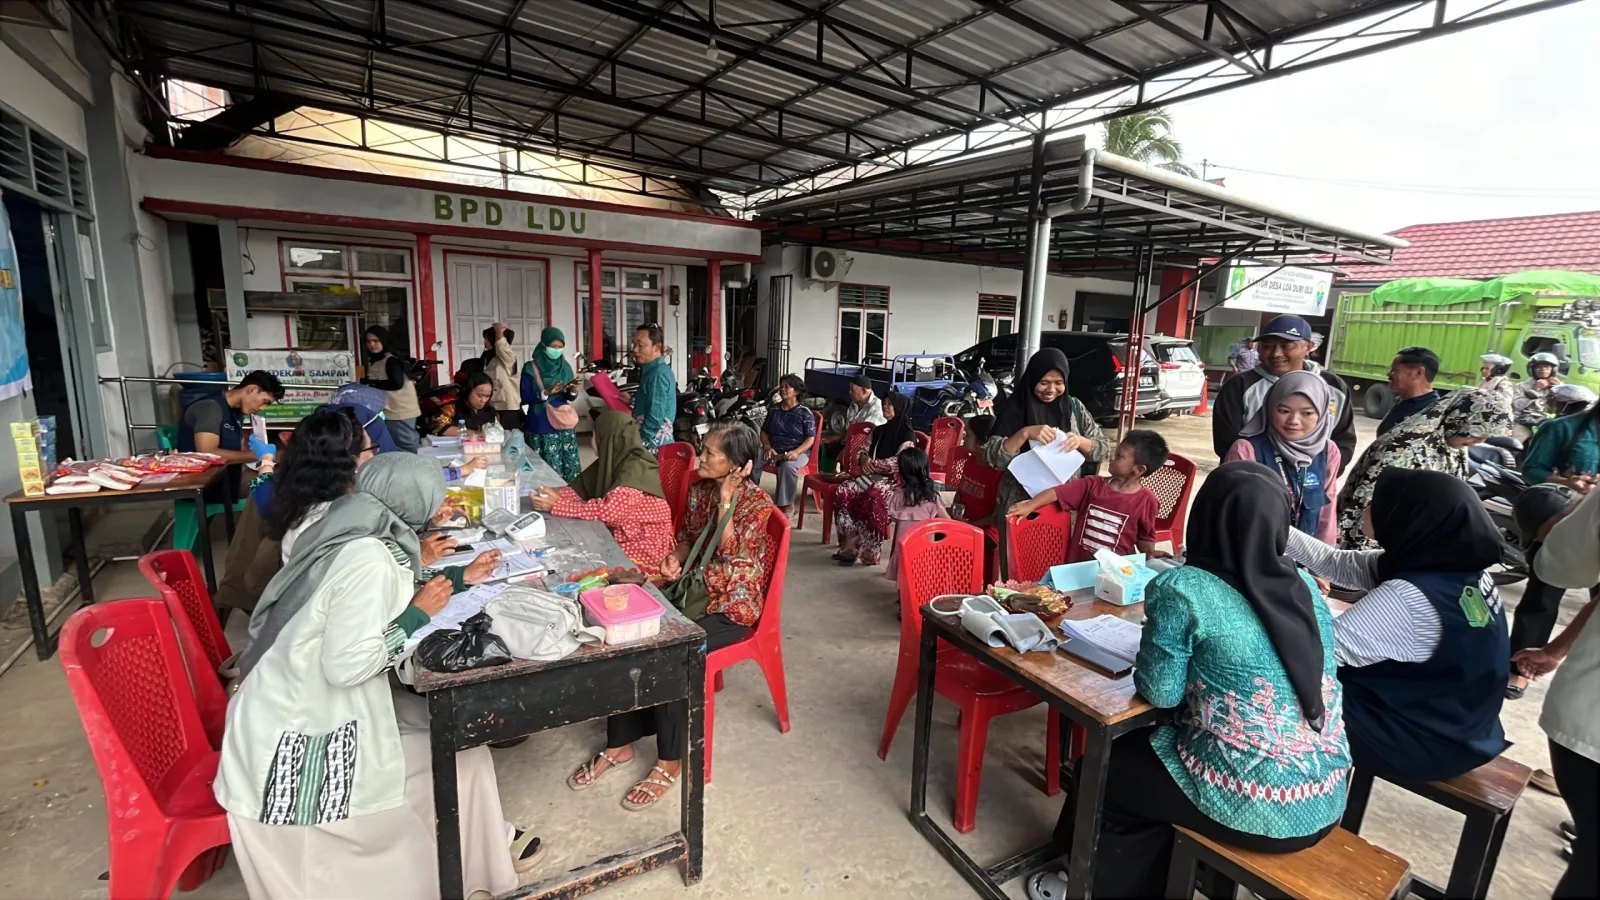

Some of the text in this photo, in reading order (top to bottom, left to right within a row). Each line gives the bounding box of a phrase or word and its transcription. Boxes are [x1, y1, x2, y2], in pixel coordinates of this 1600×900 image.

[434, 193, 586, 235] BPD LDU
[309, 369, 349, 377] SAMPAH
